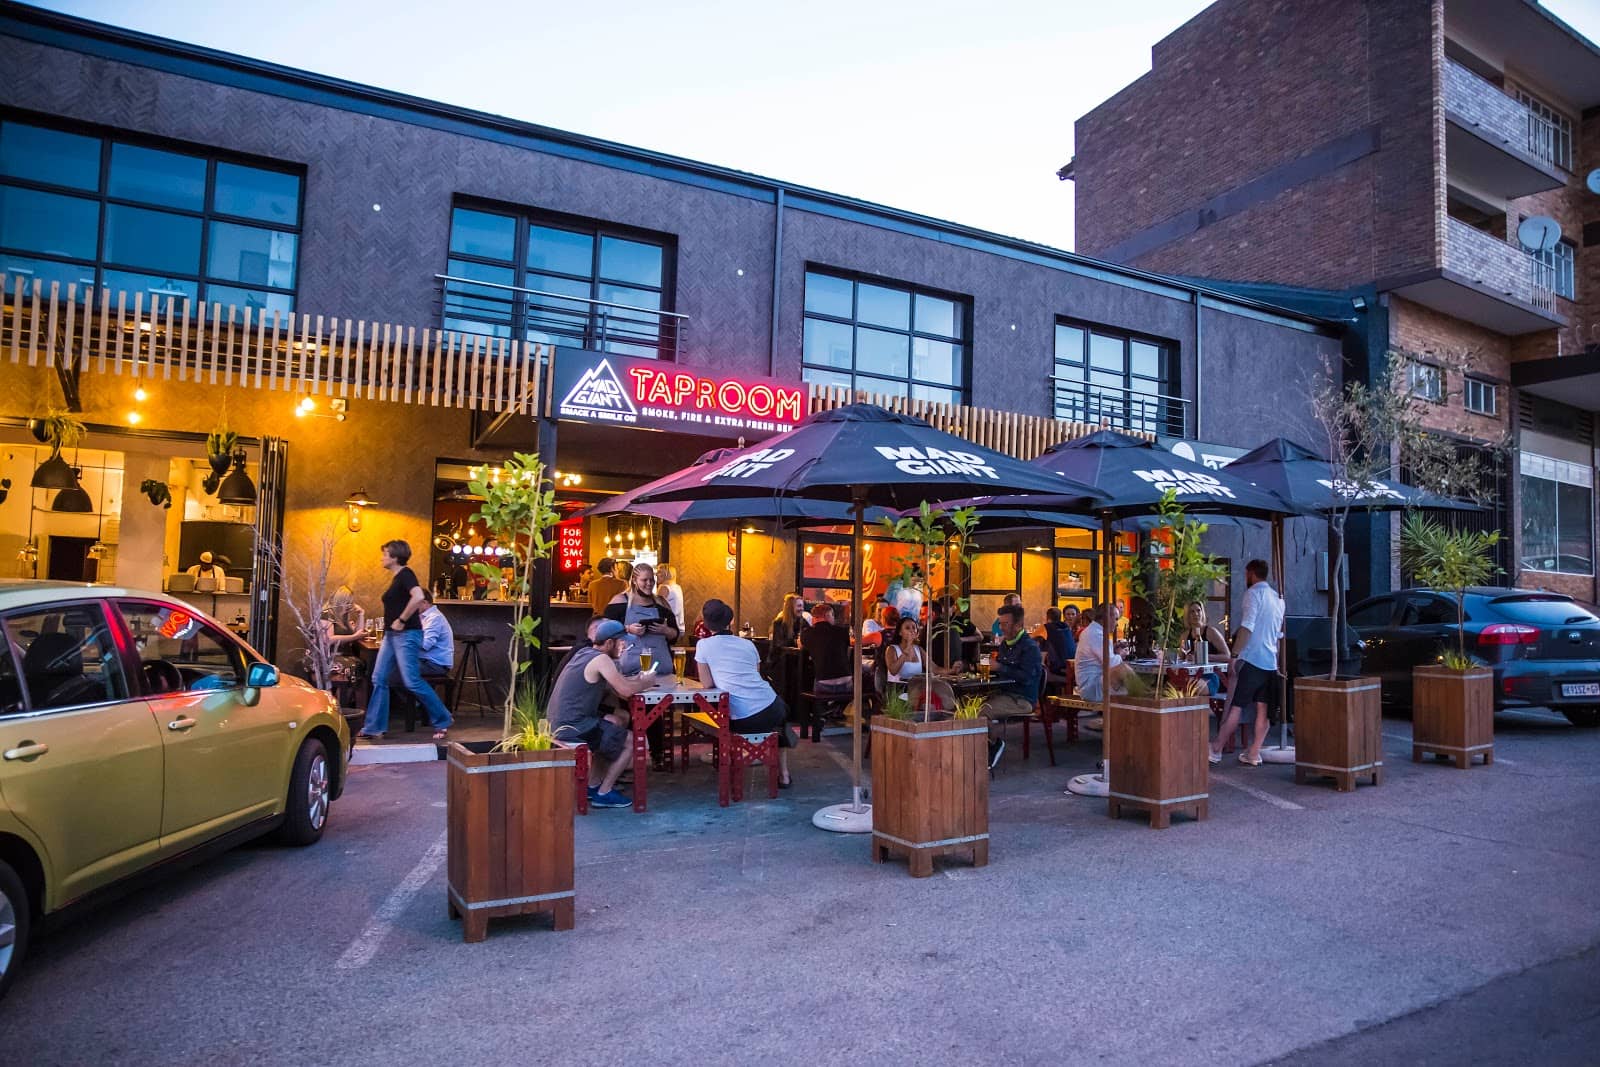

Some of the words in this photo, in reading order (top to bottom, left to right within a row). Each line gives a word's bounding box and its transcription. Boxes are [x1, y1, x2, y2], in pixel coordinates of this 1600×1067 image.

[583, 379, 620, 395] MAD
[629, 367, 801, 421] TAPROOM
[573, 390, 622, 409] GIANT
[682, 411, 703, 423] FIRE
[705, 414, 712, 424] &
[715, 416, 744, 428] EXTRA
[747, 419, 774, 431] FRESH
[777, 424, 793, 433] BEE
[873, 446, 986, 466] MAD
[895, 459, 1001, 480] GIANT
[1132, 469, 1221, 486] MAD
[563, 538, 582, 547] LOV
[564, 559, 572, 568] &
